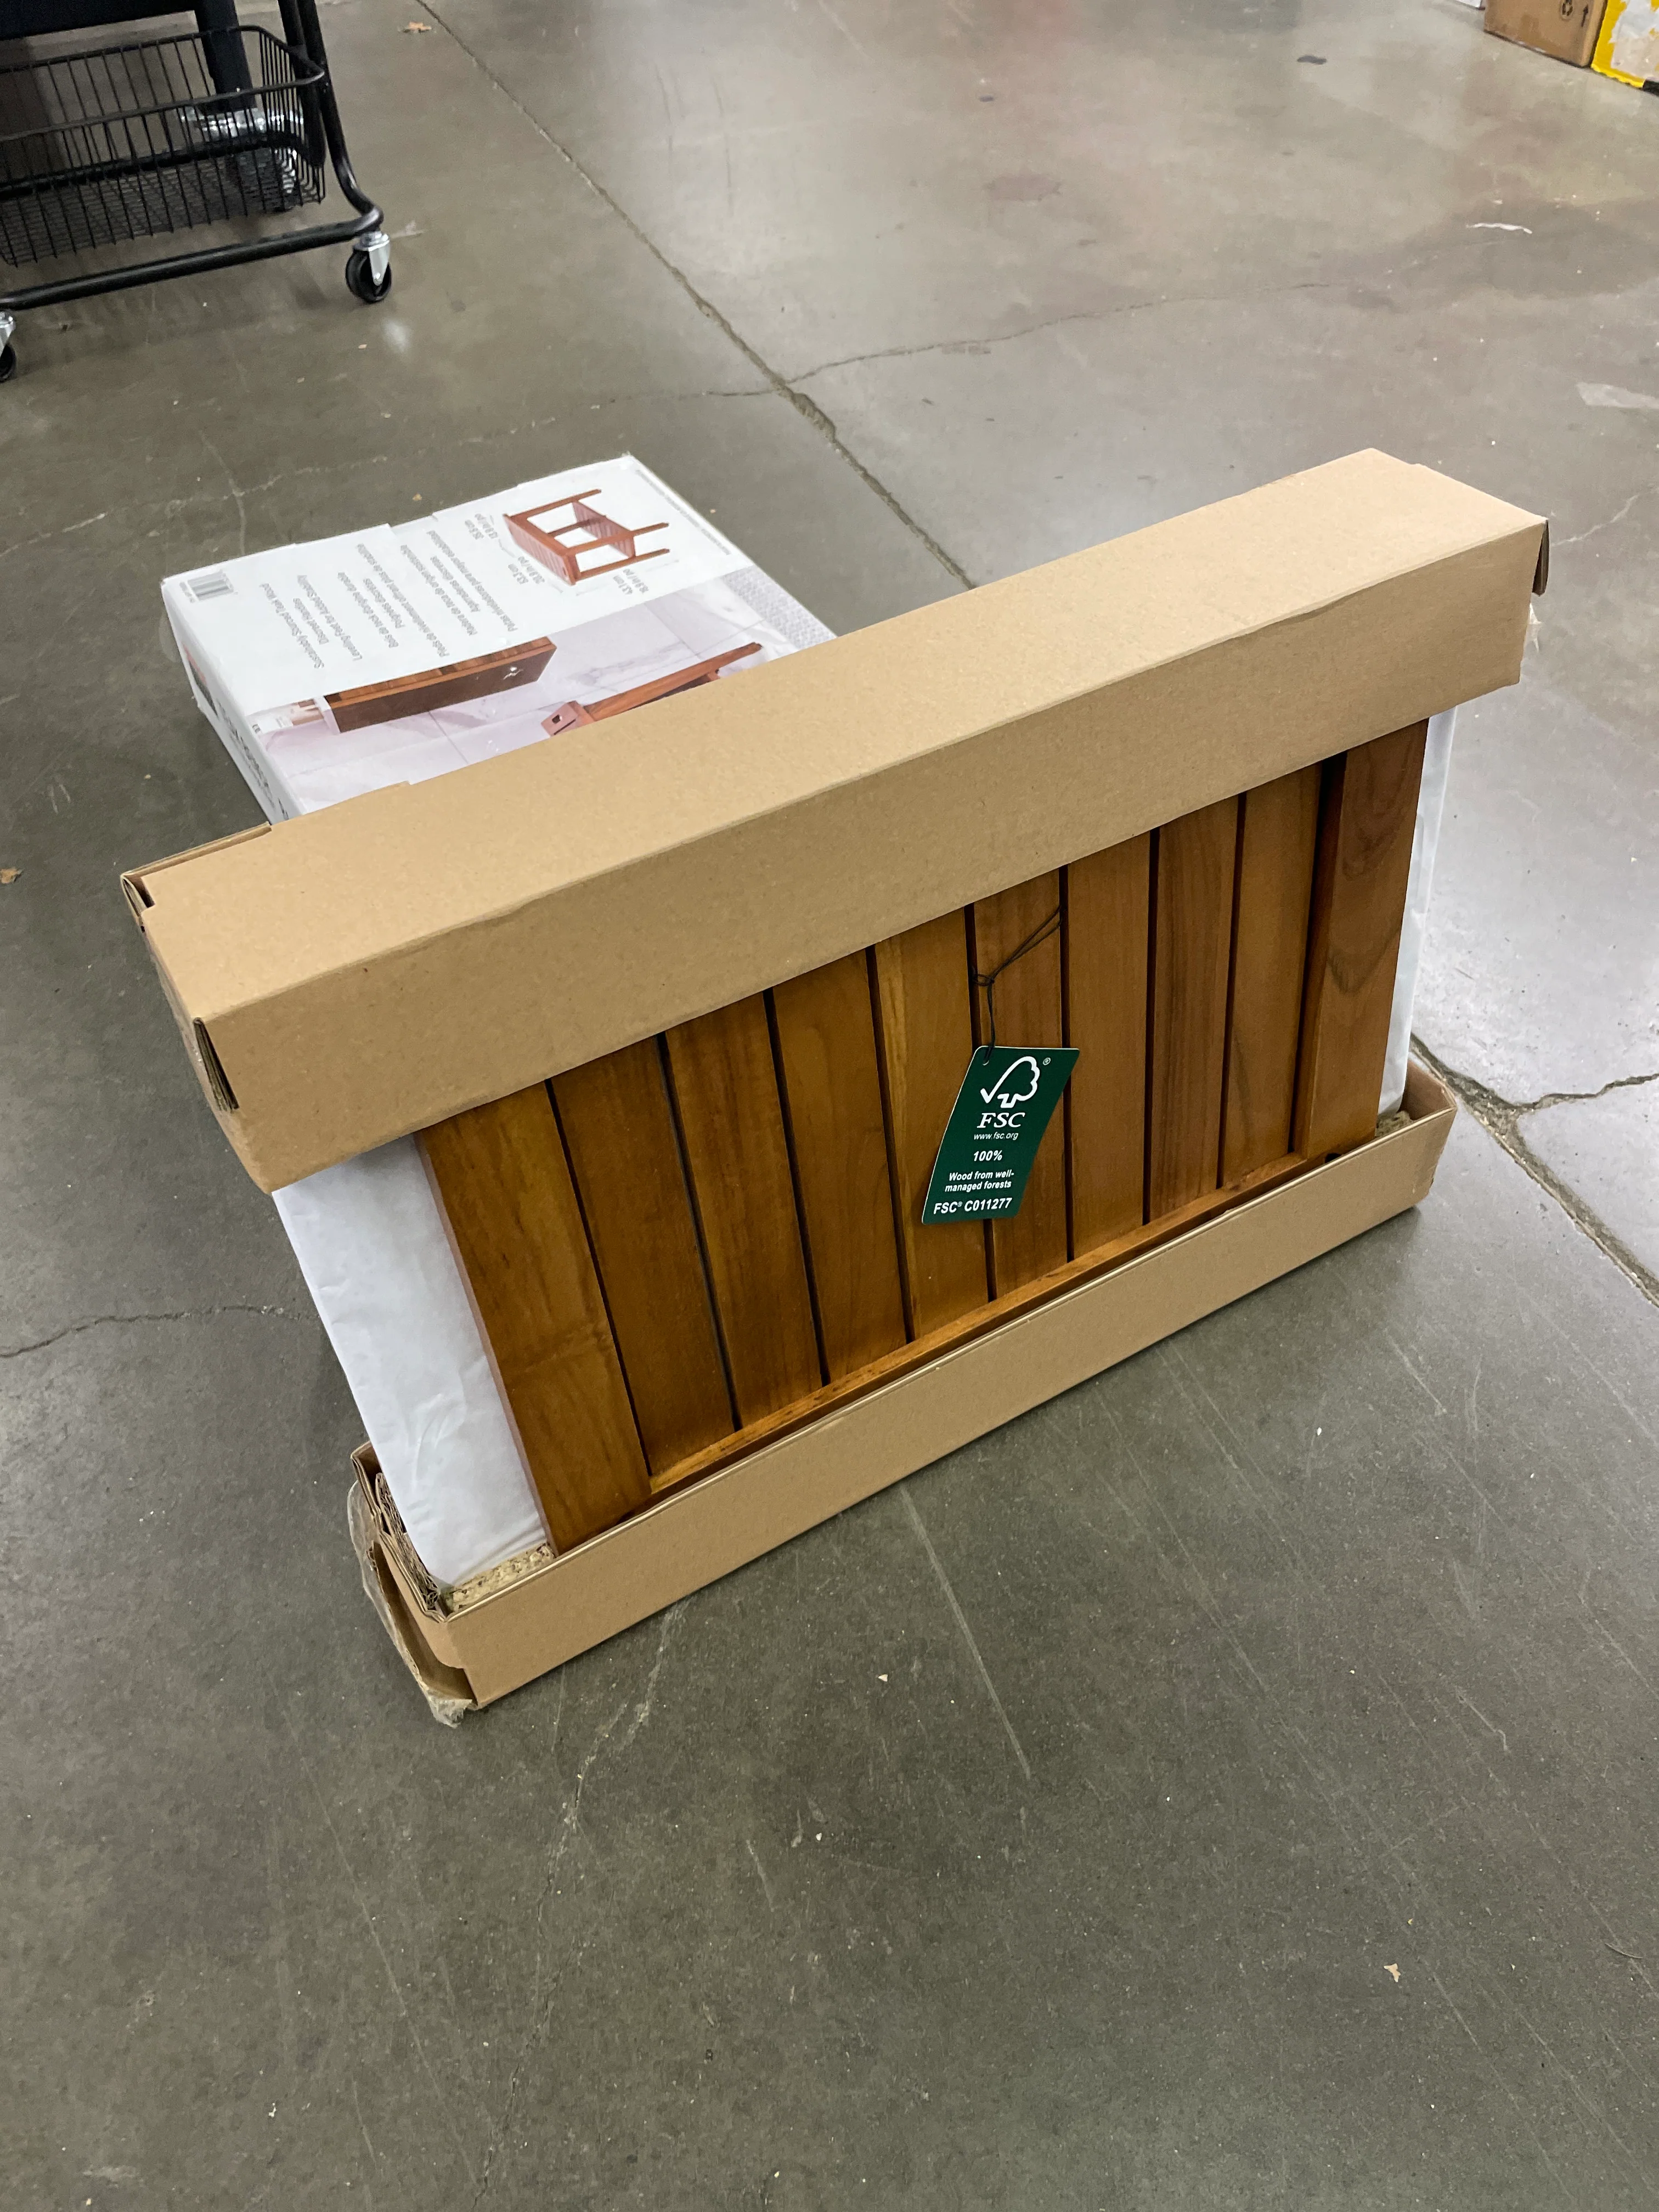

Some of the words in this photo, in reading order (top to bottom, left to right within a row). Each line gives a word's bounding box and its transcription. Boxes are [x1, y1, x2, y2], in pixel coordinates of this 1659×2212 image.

[977, 1112, 1026, 1128] FSC
[973, 1131, 1019, 1141] www.fsc.org
[973, 1150, 1002, 1161] 100%
[949, 1171, 973, 1181] Wood
[974, 1171, 994, 1180] from
[995, 1169, 1014, 1178] well-
[945, 1181, 983, 1193] managed
[984, 1180, 1012, 1189] forests
[964, 1197, 1013, 1212] C011277
